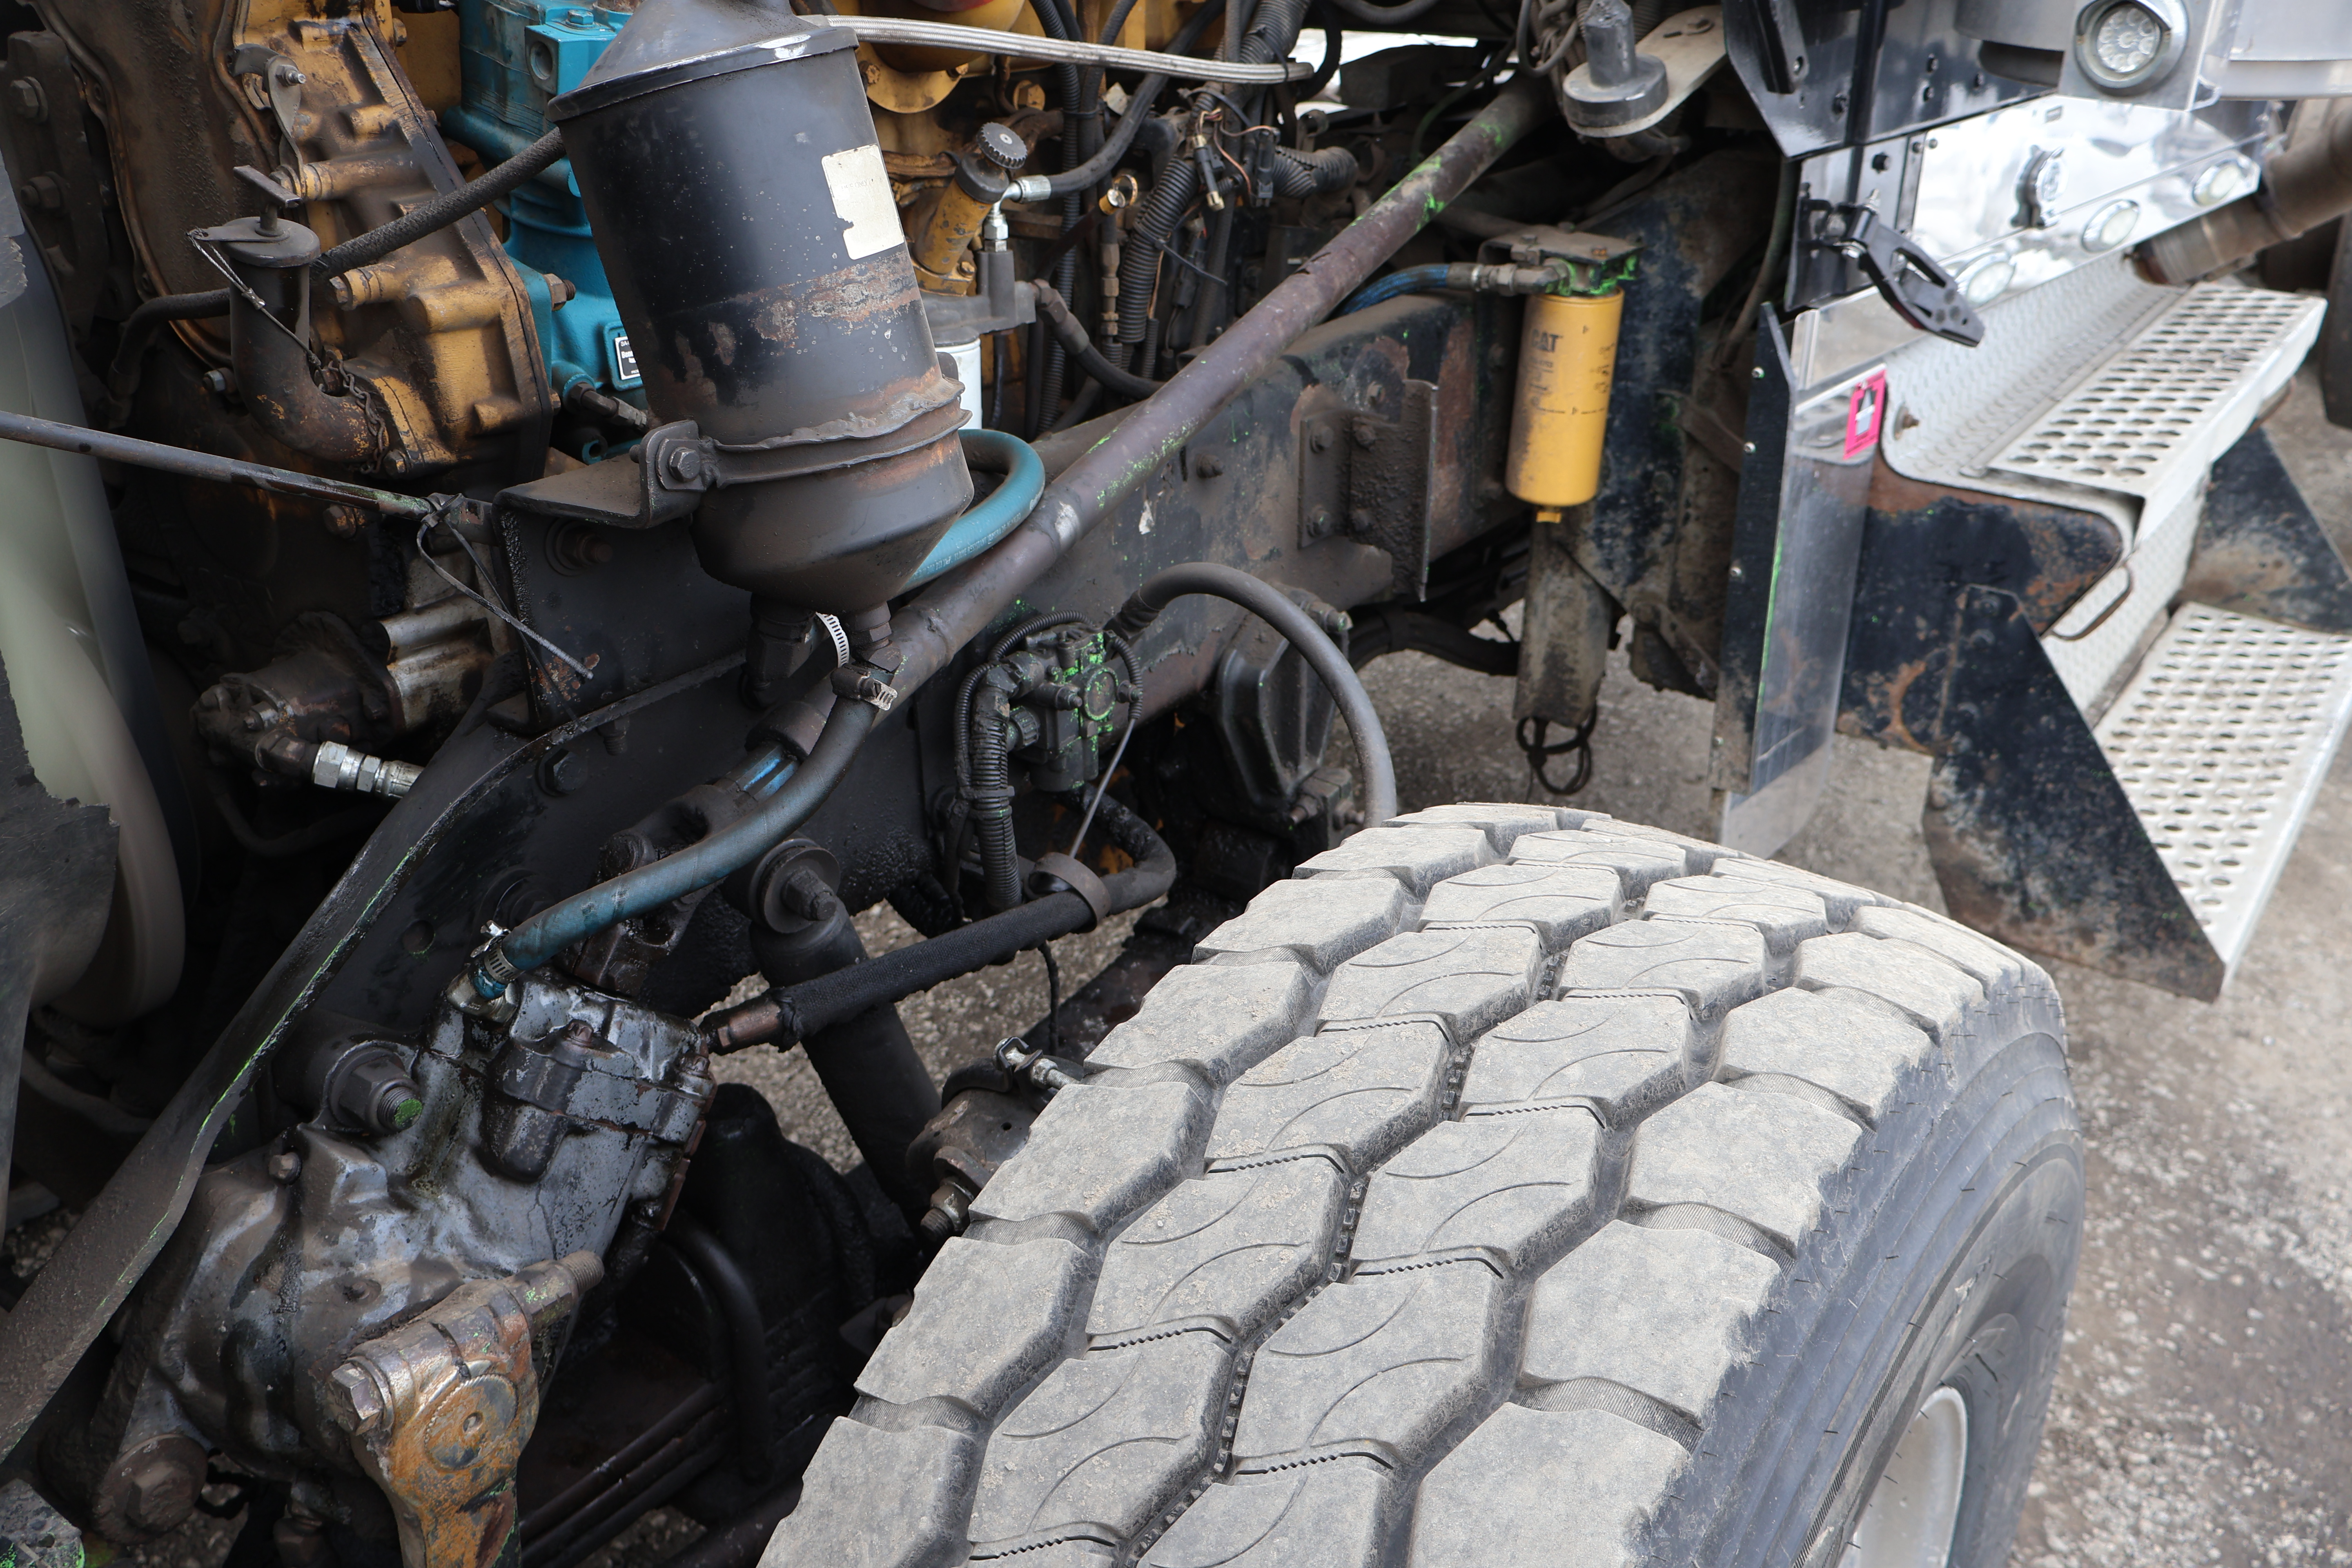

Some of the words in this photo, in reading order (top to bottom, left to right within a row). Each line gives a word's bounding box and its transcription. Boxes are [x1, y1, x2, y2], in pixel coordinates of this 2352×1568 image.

[1531, 329, 1559, 352] CAT
[955, 548, 967, 561] FLAME
[967, 537, 987, 553] RESISTANT
